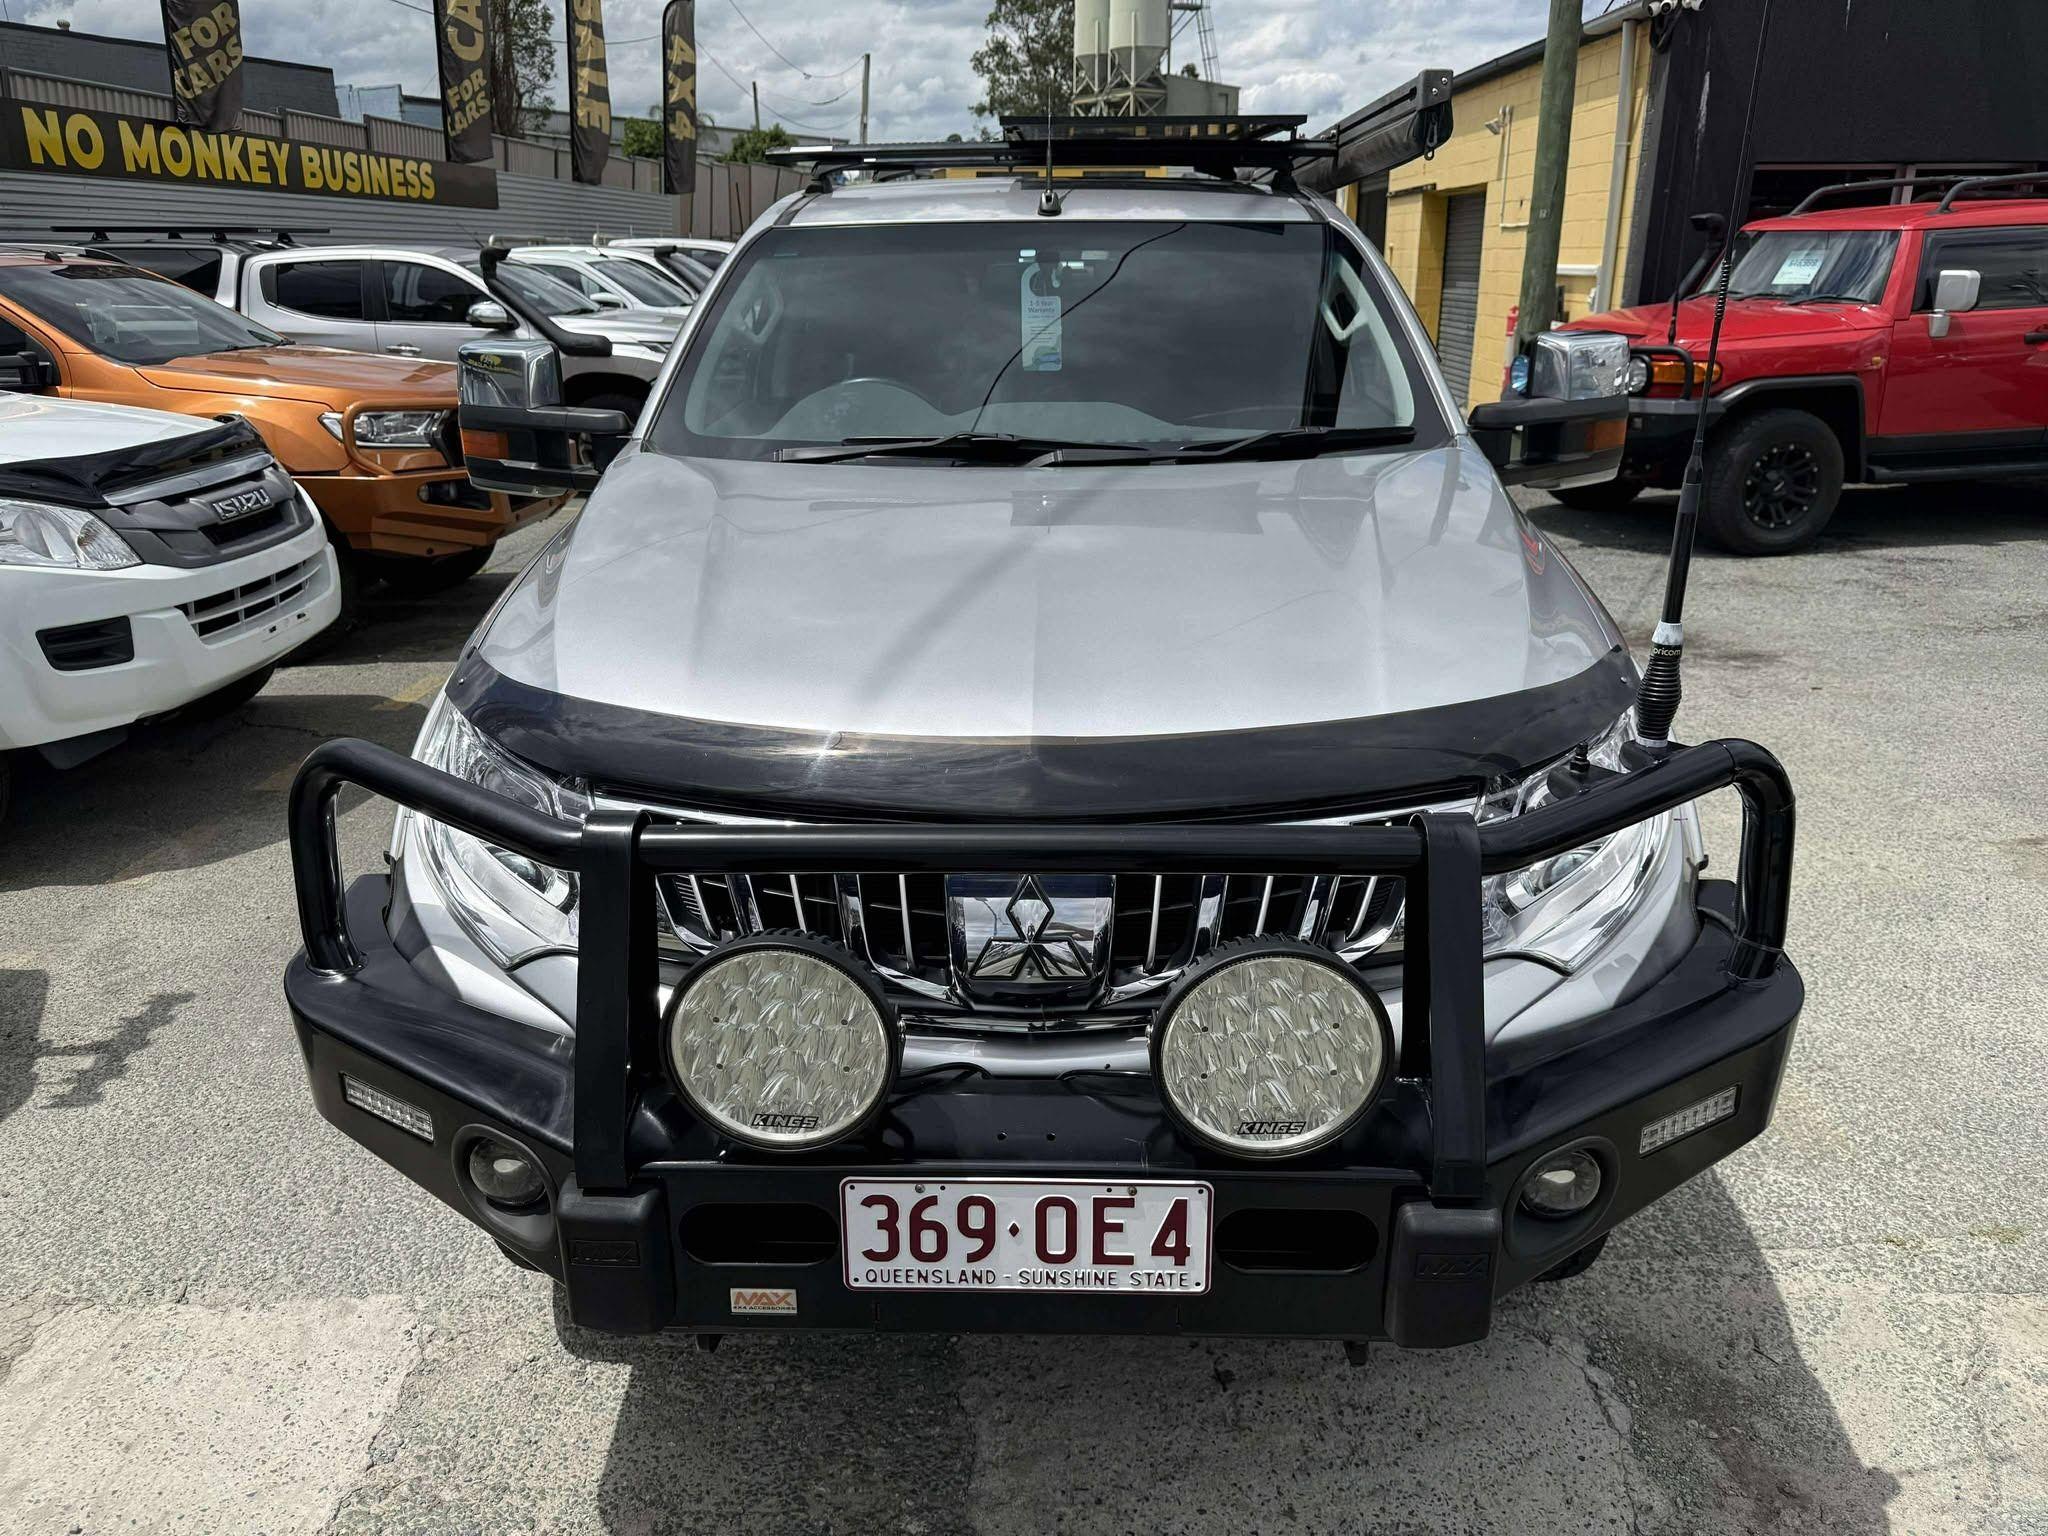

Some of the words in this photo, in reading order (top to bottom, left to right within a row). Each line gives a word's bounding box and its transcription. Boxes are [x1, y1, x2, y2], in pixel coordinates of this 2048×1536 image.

[172, 2, 237, 60] FOR
[174, 34, 243, 99] CARS
[446, 68, 487, 109] FOR
[21, 106, 105, 170] NO
[118, 120, 290, 186] MONKEY
[300, 145, 436, 200] BUSINESS
[212, 488, 271, 520] ISUZU
[1653, 647, 1681, 656] oricom
[751, 1113, 819, 1129] KINGS
[1237, 1121, 1307, 1135] KINGS
[864, 1268, 997, 1286] QUEENSLAND
[1018, 1269, 1118, 1287] SUNSHINE
[1129, 1271, 1190, 1288] STATE
[733, 1291, 794, 1306] MAX
